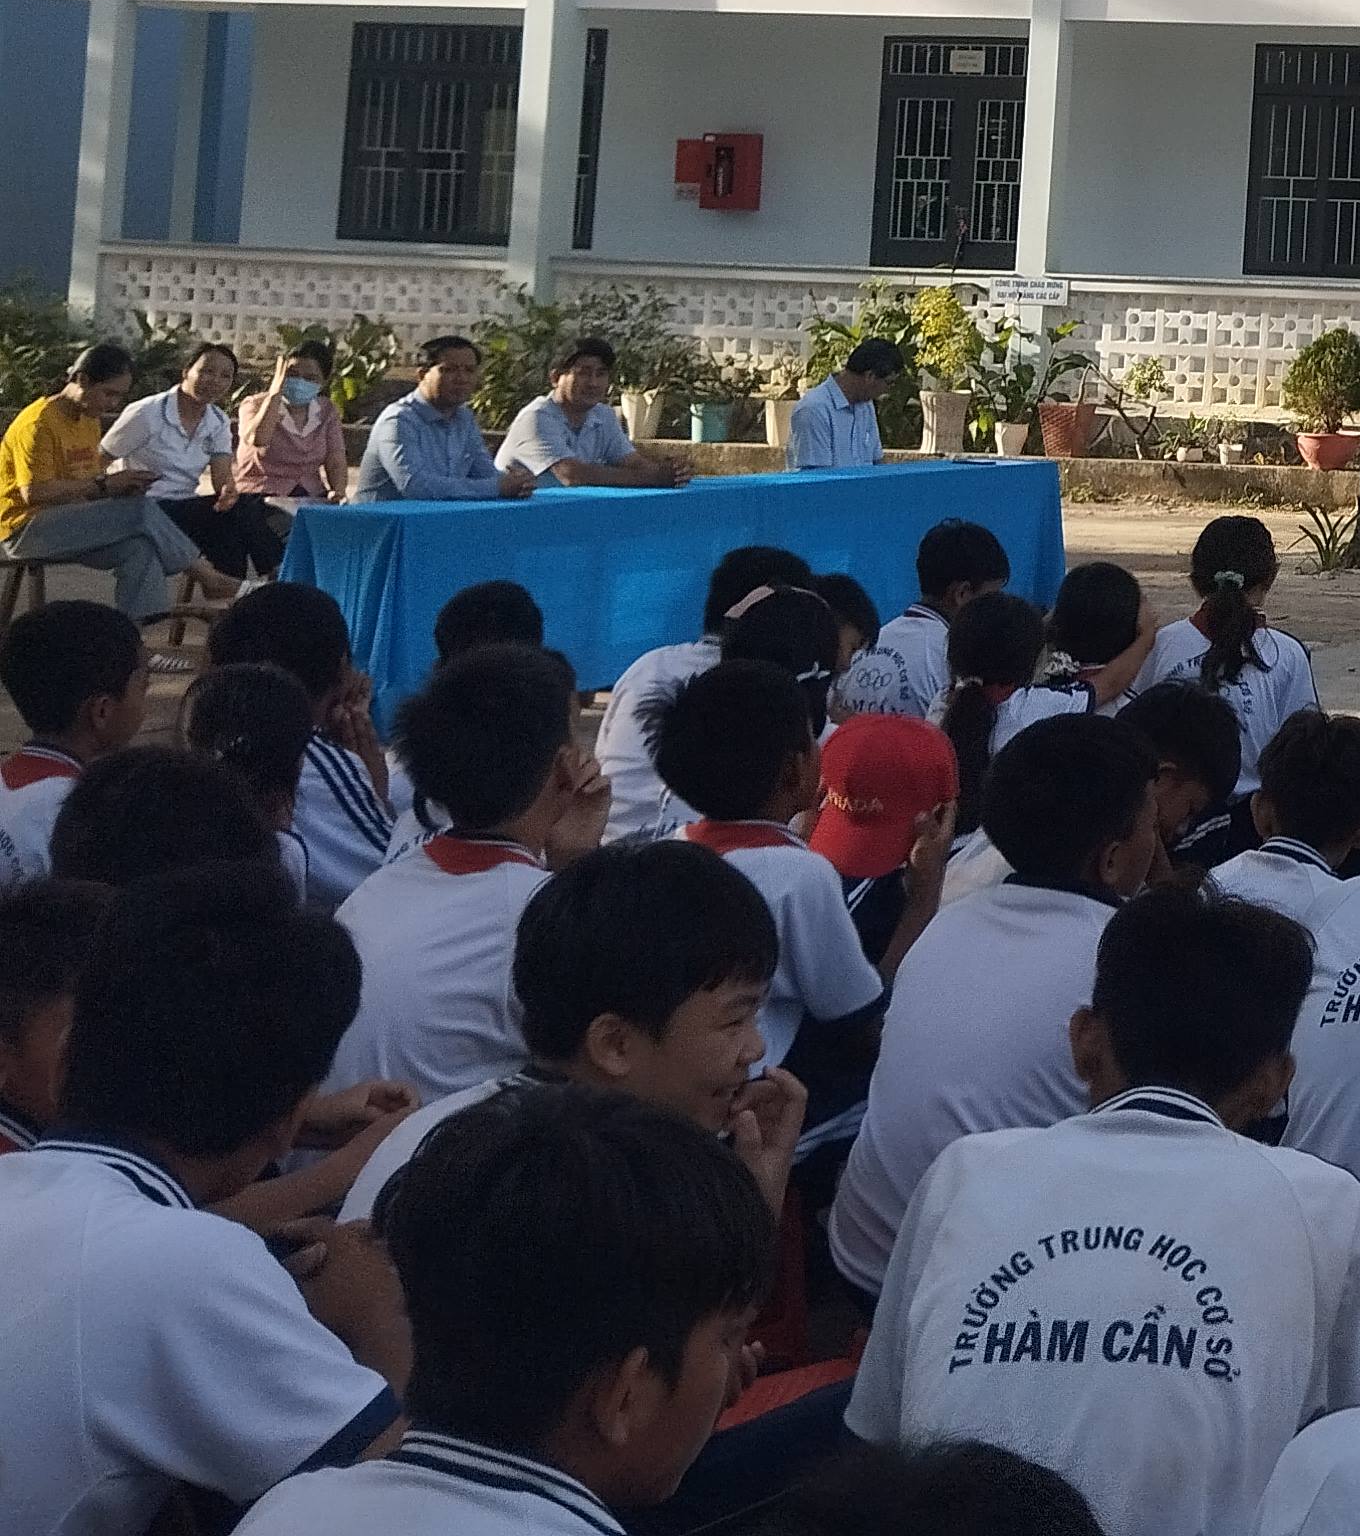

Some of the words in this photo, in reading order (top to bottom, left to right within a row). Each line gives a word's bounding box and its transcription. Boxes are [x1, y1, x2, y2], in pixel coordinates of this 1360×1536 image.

[1038, 1226, 1144, 1260] TRUNG
[1148, 1234, 1208, 1282] HỌC
[949, 1250, 1035, 1375] TRƯỜNG
[1195, 1285, 1234, 1326] CƠ
[982, 1308, 1090, 1364] HÀM
[1102, 1304, 1198, 1370] CẦN
[1203, 1336, 1242, 1383] SỞ
